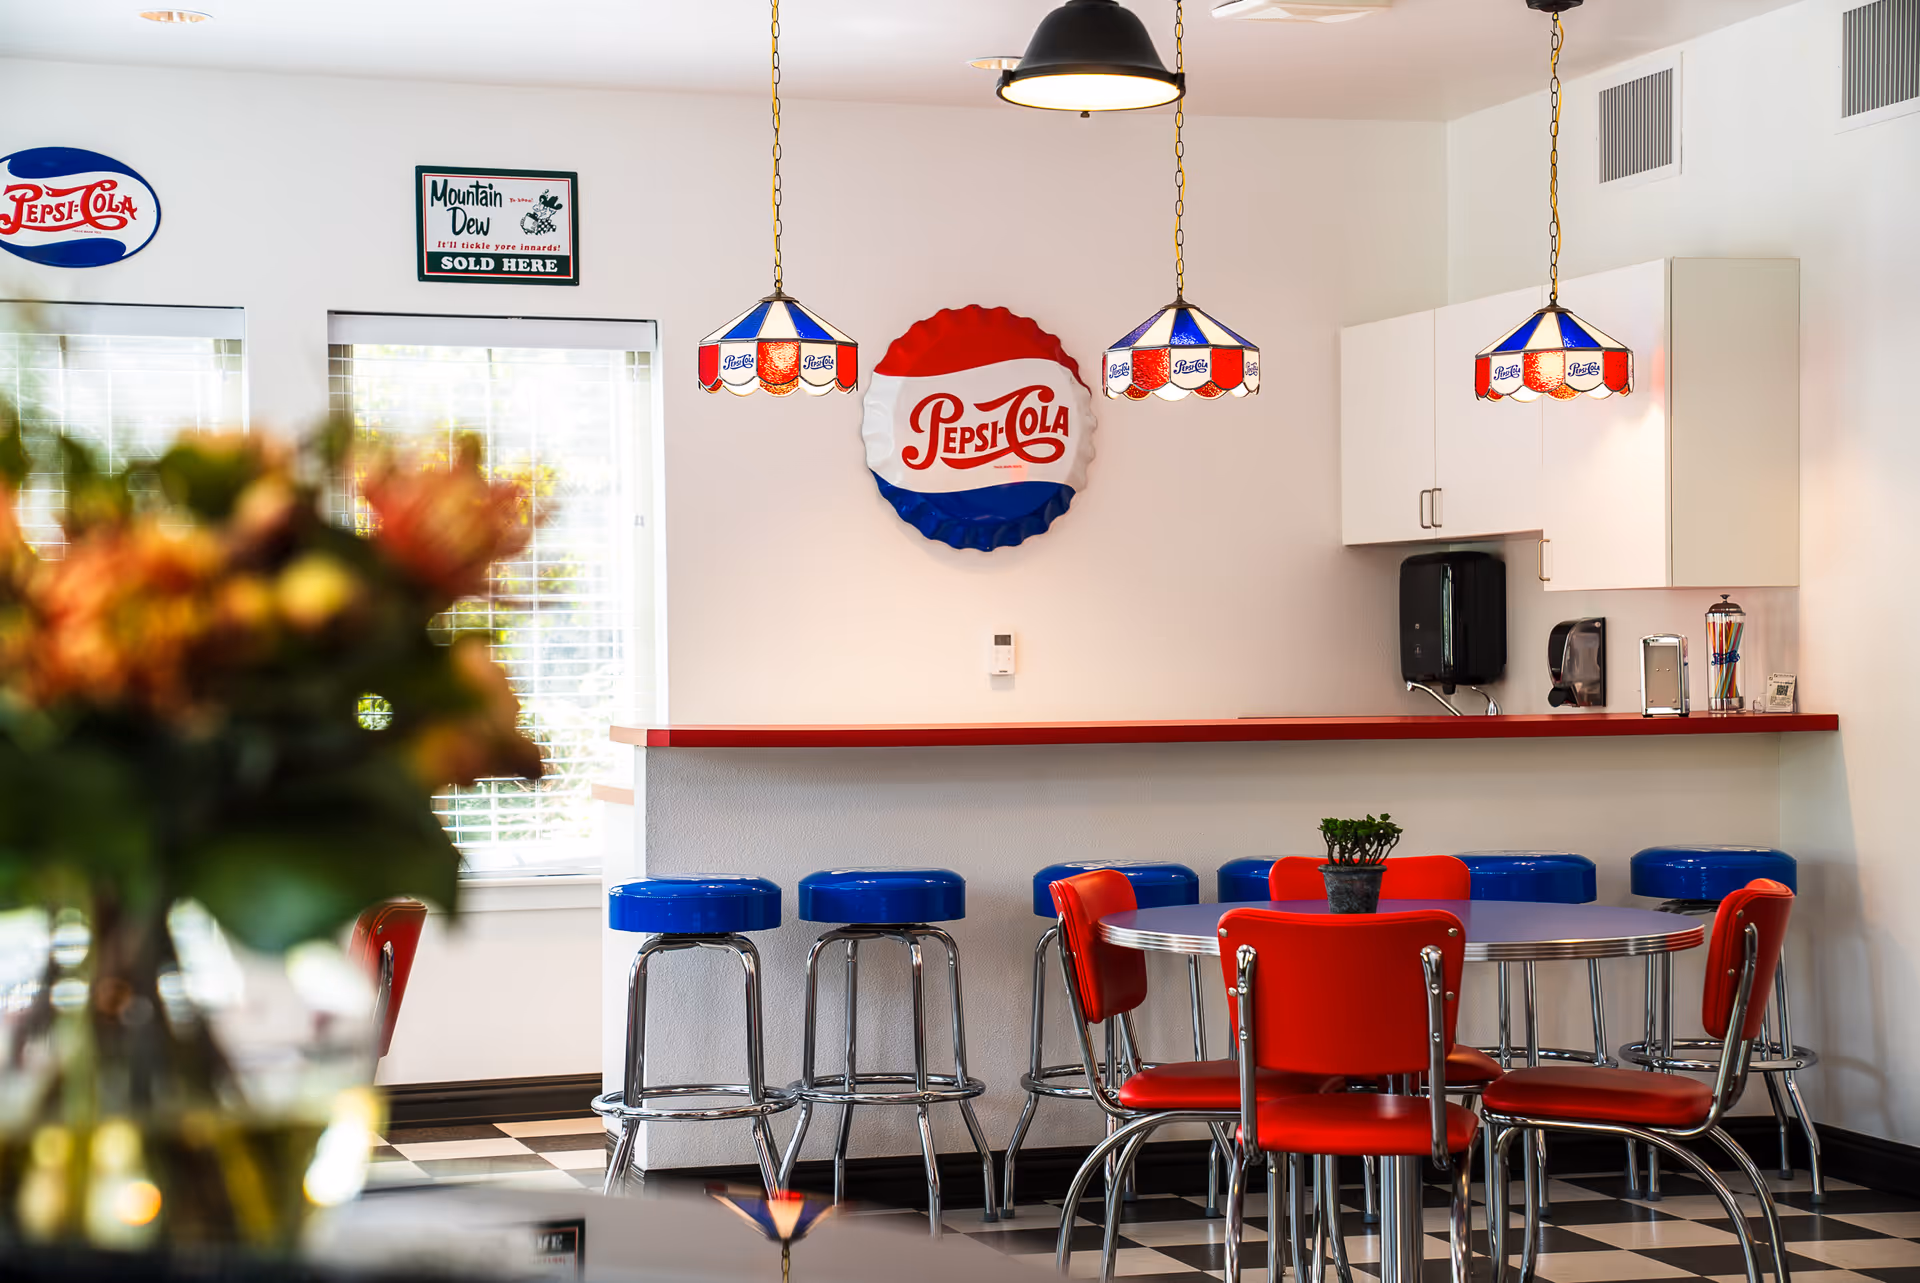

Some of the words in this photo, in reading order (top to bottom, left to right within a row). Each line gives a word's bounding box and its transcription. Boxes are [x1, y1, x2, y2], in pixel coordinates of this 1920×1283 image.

[430, 178, 503, 208] Mountain
[446, 206, 490, 236] Dew
[437, 240, 457, 249] It'll
[461, 241, 490, 250] tickle
[494, 244, 516, 252] yore
[520, 244, 561, 252] innards!
[440, 256, 495, 271] SOLD
[502, 258, 558, 273] HERE
